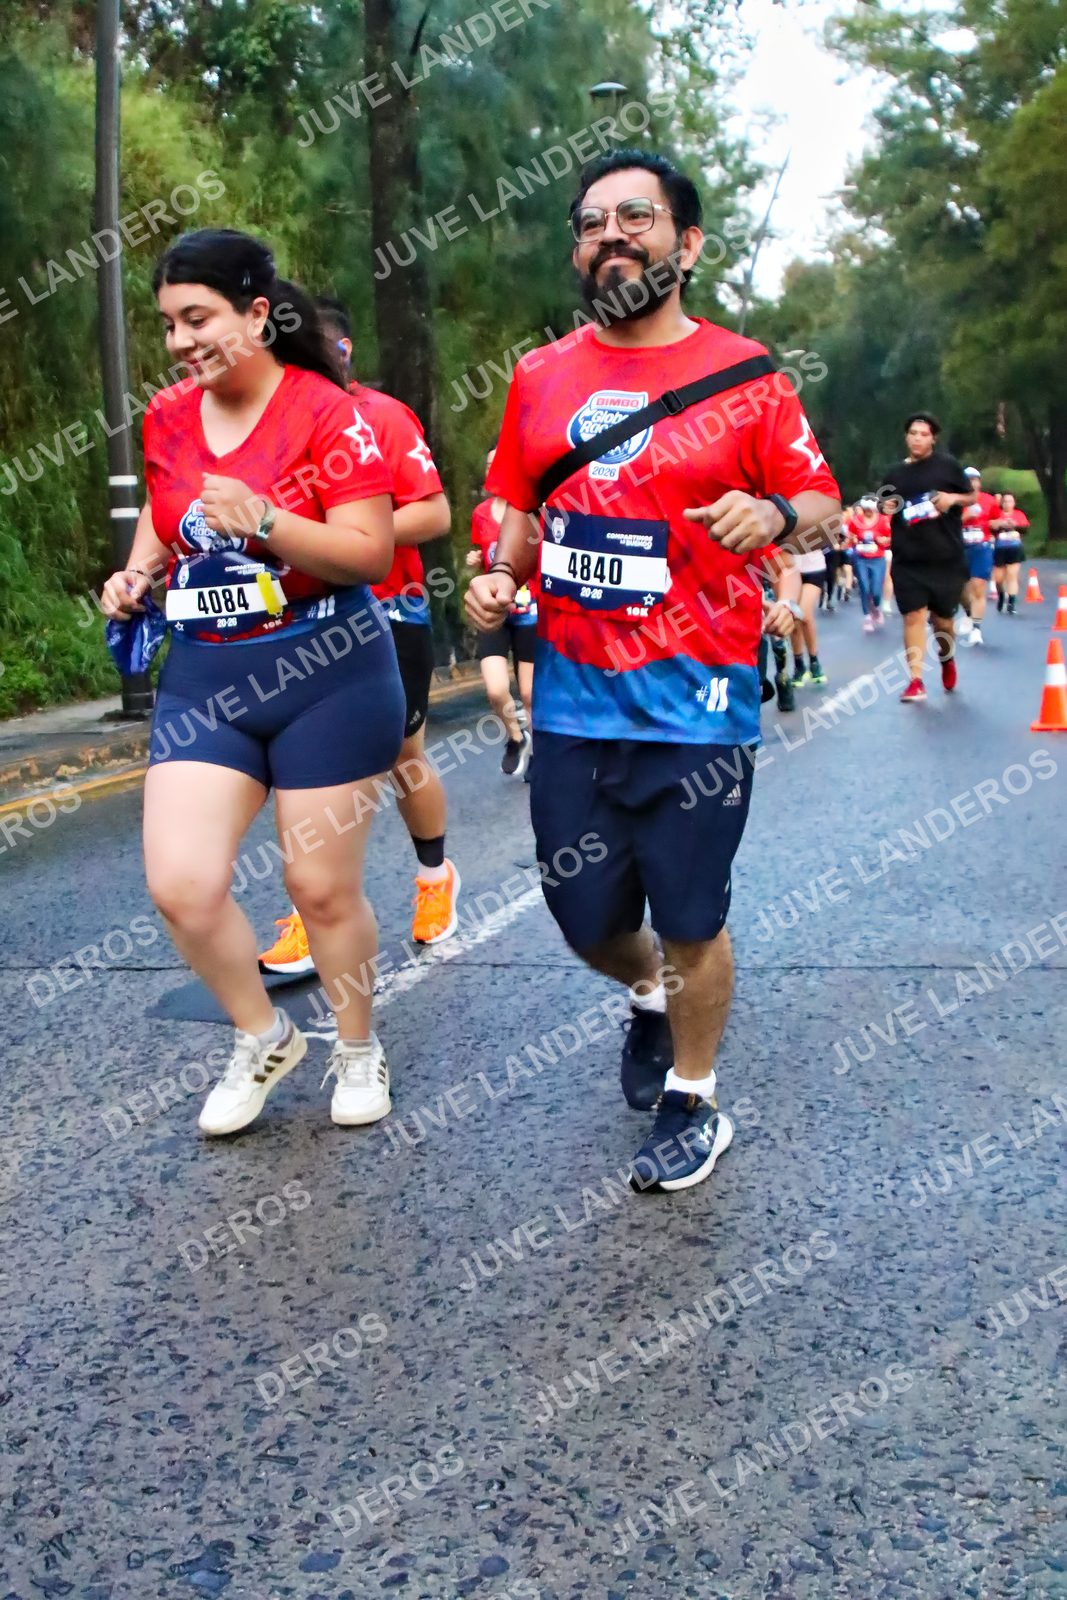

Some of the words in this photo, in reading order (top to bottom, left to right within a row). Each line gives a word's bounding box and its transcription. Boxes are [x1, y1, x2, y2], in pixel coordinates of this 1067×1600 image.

[596, 397, 639, 408] BIMBO
[592, 466, 617, 478] 2026
[568, 552, 623, 585] 4840
[197, 586, 250, 614] 4084
[627, 606, 648, 617] 10K
[262, 619, 284, 630] 10K
